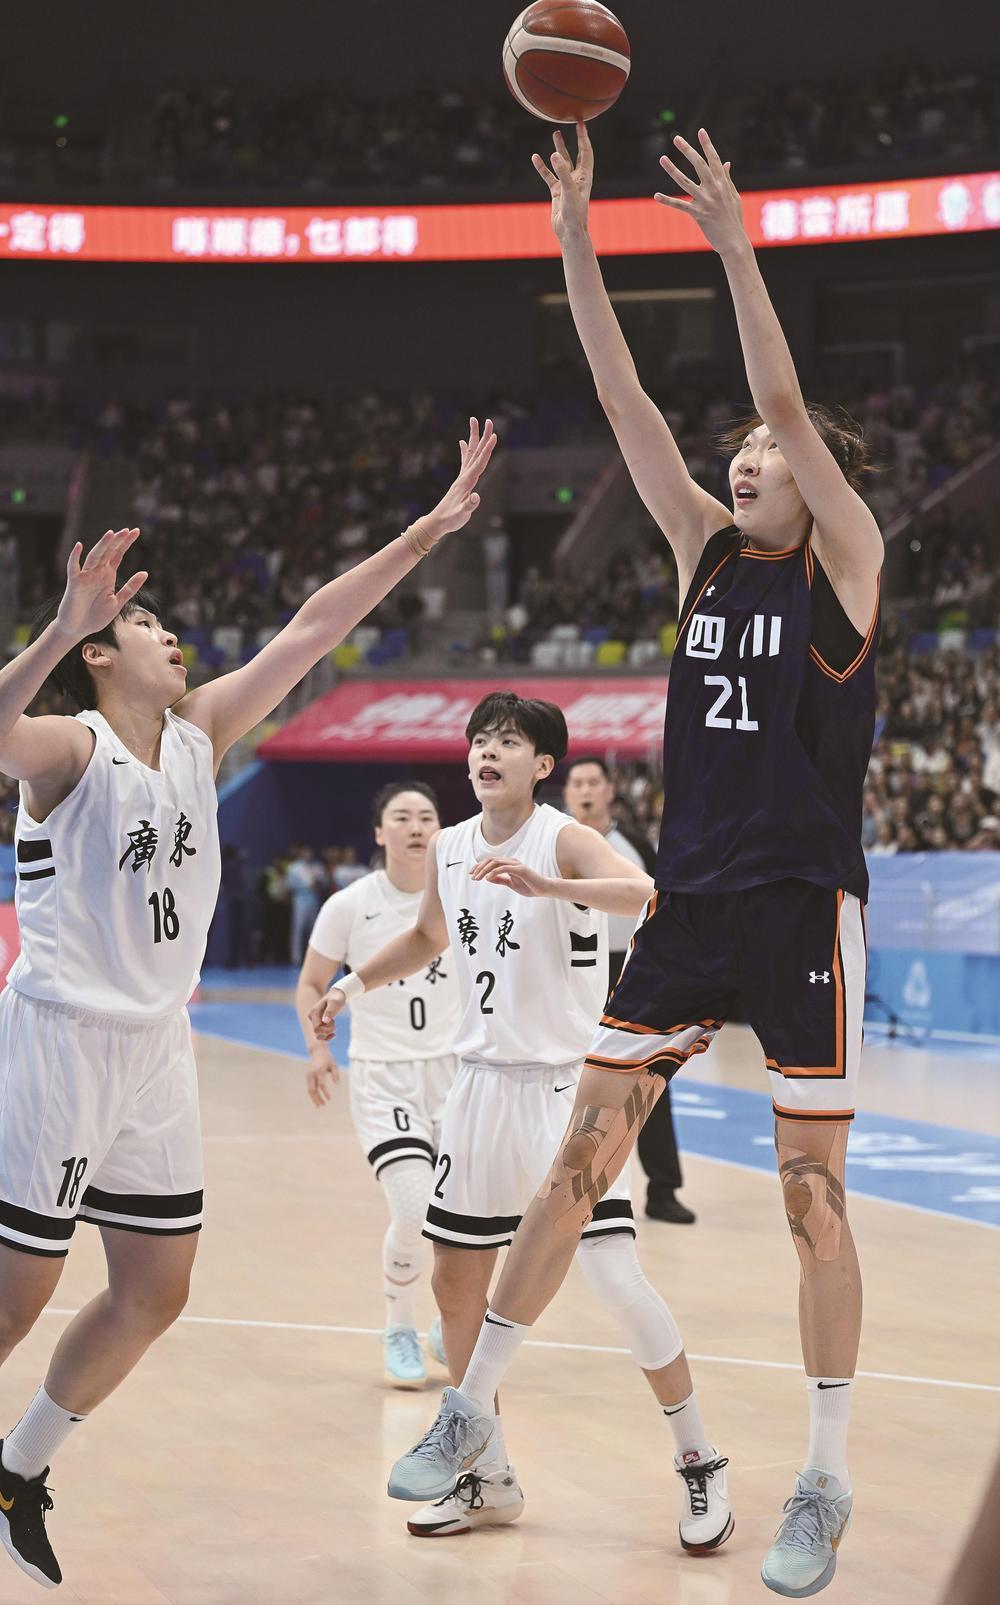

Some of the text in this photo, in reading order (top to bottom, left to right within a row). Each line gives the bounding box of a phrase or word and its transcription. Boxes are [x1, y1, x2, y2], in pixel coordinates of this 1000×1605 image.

[686, 613, 782, 660] 四川
[704, 675, 759, 731] 21
[119, 811, 197, 874] 廣東
[148, 887, 180, 944] 18
[457, 908, 521, 958] 廣東
[410, 997, 426, 1031] 0
[476, 970, 496, 1015] 2
[56, 1156, 89, 1209] 18
[434, 1153, 452, 1200] 2
